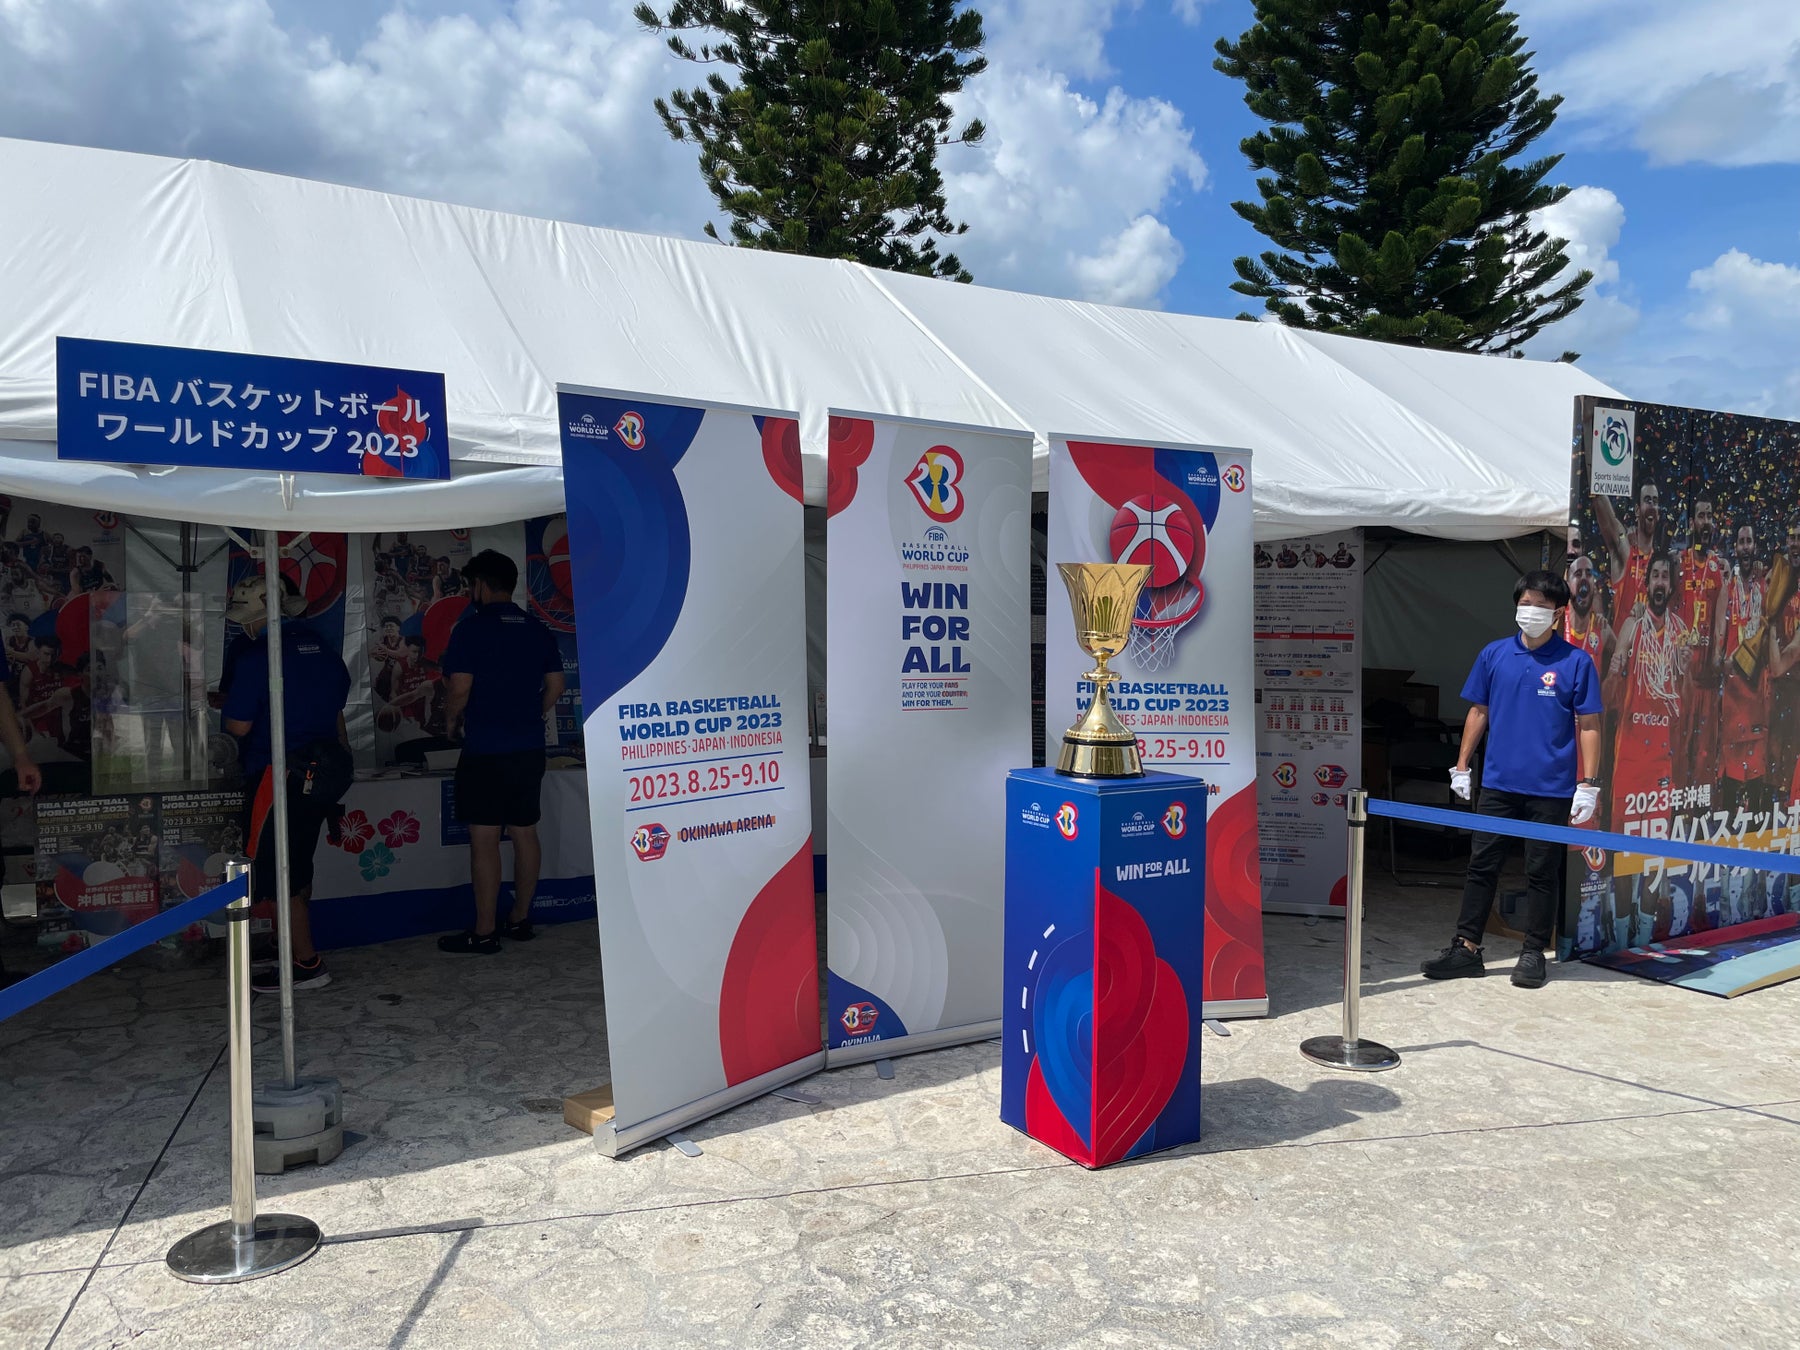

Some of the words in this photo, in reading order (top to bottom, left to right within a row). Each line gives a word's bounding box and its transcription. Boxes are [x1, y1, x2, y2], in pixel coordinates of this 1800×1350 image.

[79, 372, 160, 403] FIBA
[171, 378, 431, 423] バスケットボール
[97, 414, 337, 453] ワールドカップ
[347, 429, 418, 458] 2023
[569, 426, 594, 434] WORLD
[1594, 472, 1611, 481] Sports
[1593, 482, 1630, 495] OKINAWA
[928, 532, 944, 541] FIBA
[902, 542, 968, 551] BASKETBALL
[902, 550, 944, 561] WORLD
[947, 552, 969, 562] CUP
[901, 581, 968, 609] WIN
[902, 615, 970, 641] FOR
[901, 646, 970, 673] ALL
[1119, 683, 1229, 695] BASKETBALL
[618, 703, 662, 719] FIBA
[666, 695, 781, 716] BASKETBALL
[1144, 698, 1181, 711] CUP
[1185, 699, 1229, 712] 2023
[619, 720, 690, 741] WORLD
[694, 716, 732, 734] CUP
[737, 712, 782, 731] 2023
[629, 760, 780, 802] 2023.8.25-9.10
[63, 798, 129, 808] BASKETBALL
[1625, 784, 1711, 815] 2023年沖縄
[102, 805, 129, 813] 2023
[1022, 813, 1039, 821] WORLD
[680, 820, 734, 842] OKINAWA
[736, 814, 773, 833] ARENA
[1121, 825, 1142, 833] WORLD
[1116, 864, 1143, 881] WIN
[1145, 862, 1162, 872] FOR
[1164, 858, 1190, 876] ALL
